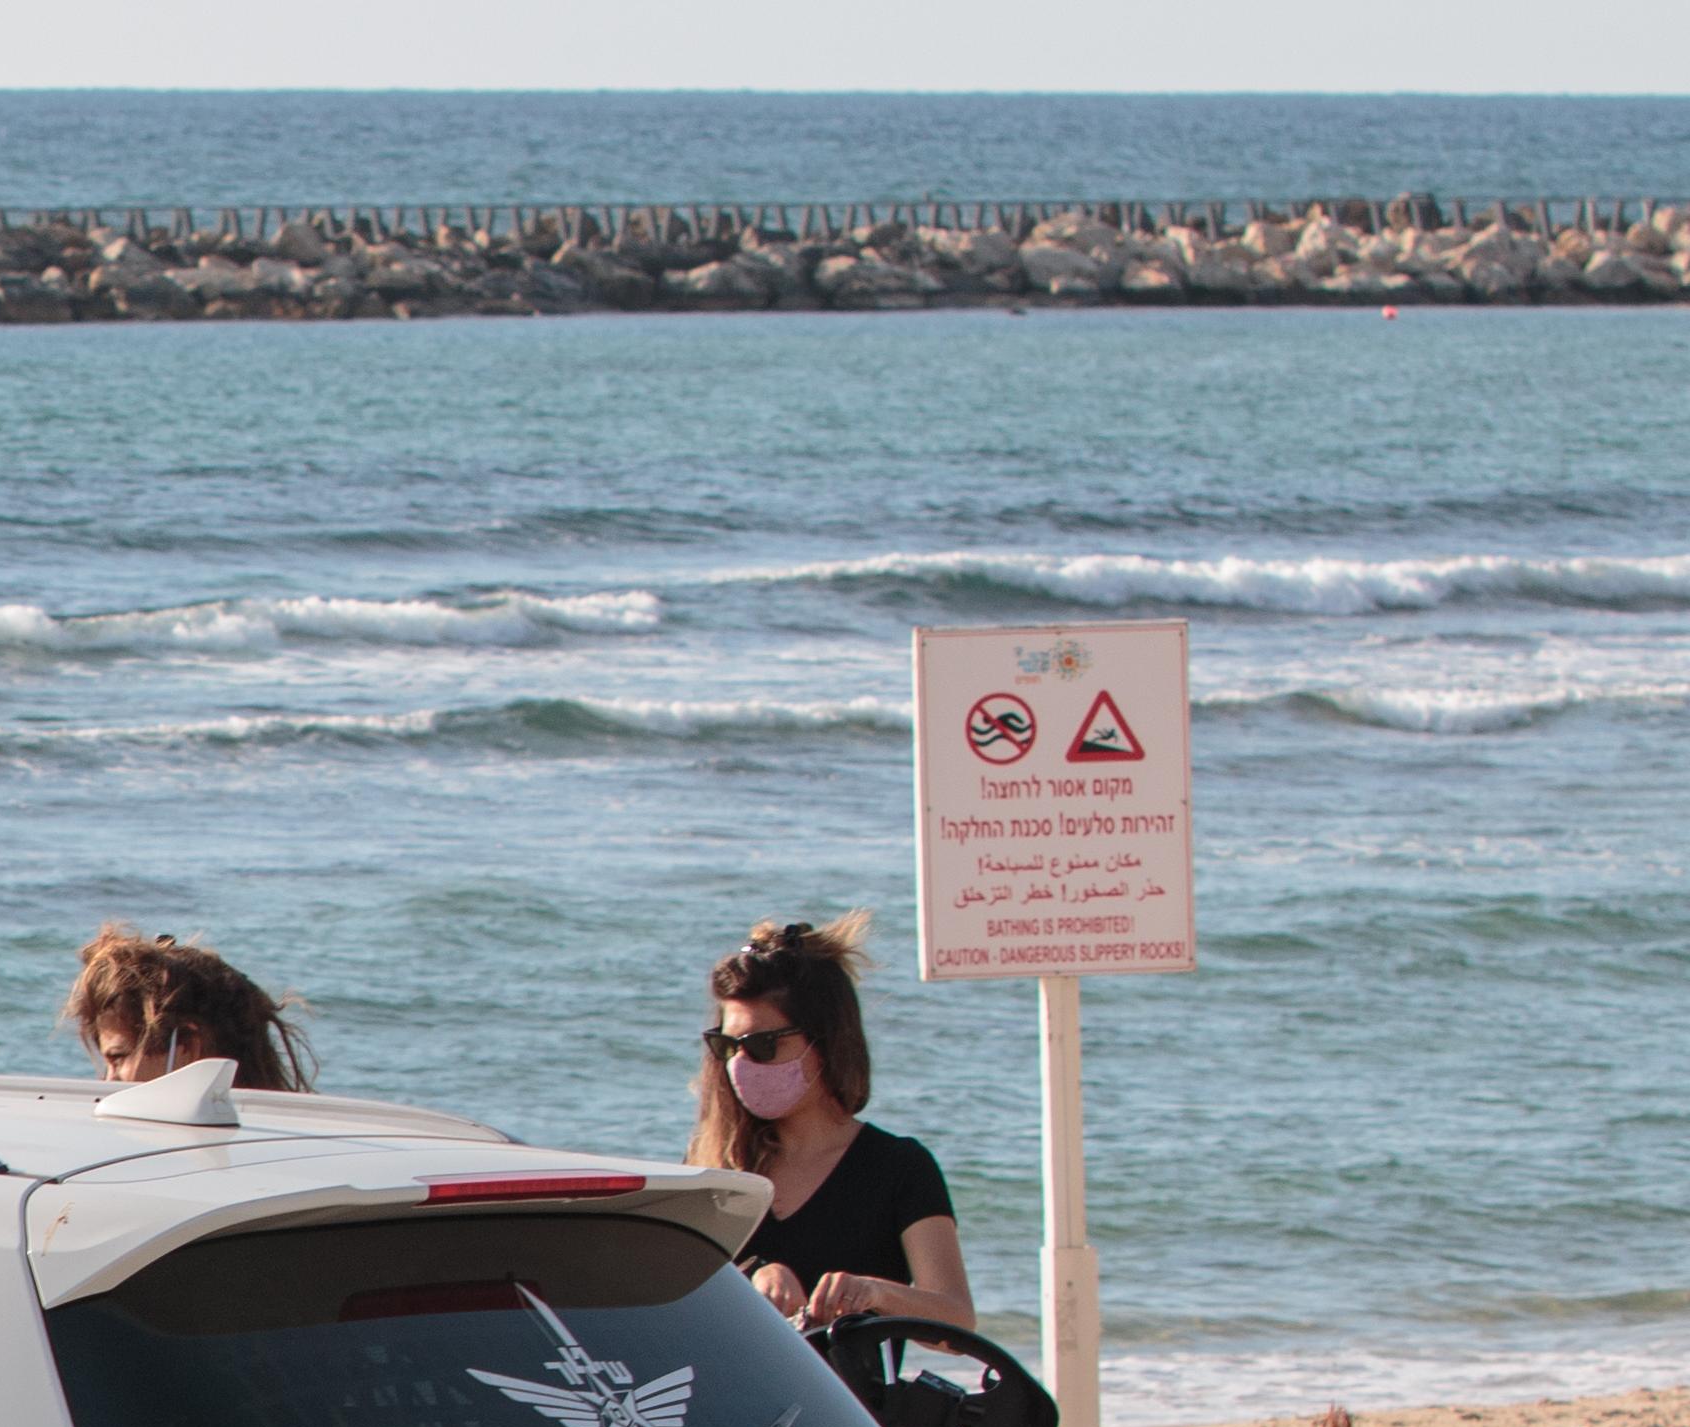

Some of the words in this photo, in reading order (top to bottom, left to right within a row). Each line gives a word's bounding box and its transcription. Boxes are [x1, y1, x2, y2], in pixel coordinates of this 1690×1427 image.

[980, 775, 1041, 800] לרחצה!
[1047, 778, 1086, 796] אסור
[1093, 777, 1132, 801] מקום
[941, 813, 1004, 845] החלקה!
[1010, 818, 1052, 837] סכנת
[1059, 811, 1115, 836] סלעים!
[1120, 814, 1175, 834] זהירות
[987, 918, 1039, 936] BATHING
[1043, 918, 1053, 934] IS
[936, 947, 989, 966] CAUTION
[1000, 945, 1076, 964] DANGEROUS
[1080, 943, 1137, 961] SLIPPERY
[1140, 941, 1186, 959] ROCKS!
